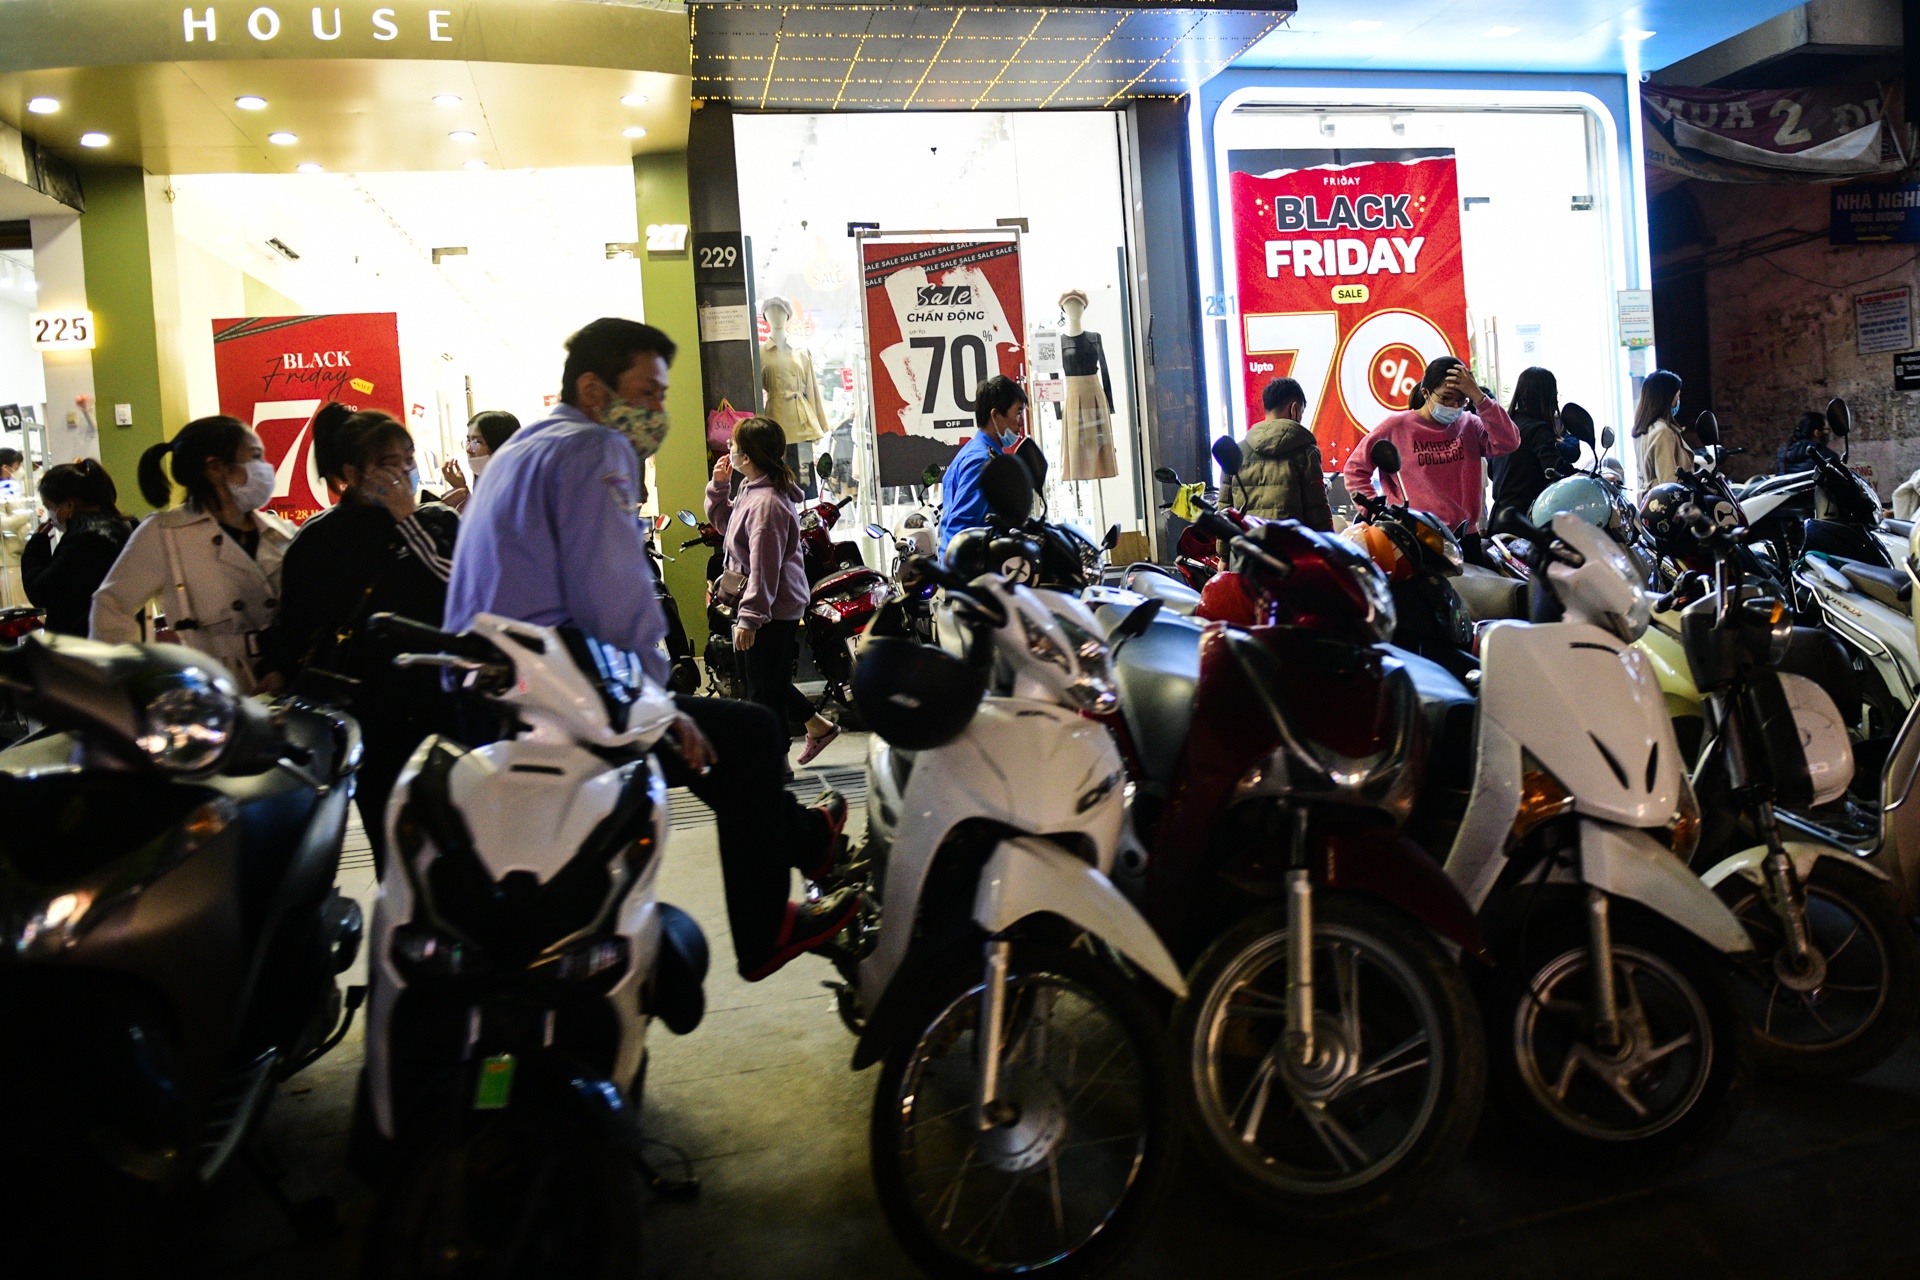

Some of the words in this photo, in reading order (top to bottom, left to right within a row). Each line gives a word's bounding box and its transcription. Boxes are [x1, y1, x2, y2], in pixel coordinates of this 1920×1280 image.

[182, 6, 453, 42] HOUSE
[1769, 99, 1812, 146] 2
[1836, 190, 1872, 210] NHÀ
[1275, 194, 1414, 232] BLACK
[700, 246, 737, 268] 229
[881, 258, 899, 268] SALE
[900, 253, 918, 263] SALE
[919, 249, 936, 259] SALE
[938, 245, 955, 255] SALE
[956, 241, 974, 250] SALE
[1264, 236, 1426, 279] FRIDAY
[865, 277, 883, 287] SALE
[940, 260, 957, 270] SALE
[958, 255, 976, 264] SALE
[977, 250, 994, 260] SALE
[995, 246, 1013, 256] SALE
[914, 283, 972, 311] Sale
[1338, 289, 1363, 299] SALE
[907, 309, 943, 323] CHẤN
[947, 309, 985, 323] ĐỘNG
[1206, 295, 1236, 317] 231
[35, 317, 87, 342] 225
[283, 350, 352, 369] BLACK
[1250, 362, 1274, 374] Upto
[262, 356, 352, 402] Friday
[4, 415, 20, 427] 70
[946, 420, 961, 428] OFF
[1413, 434, 1464, 453] AMHERST
[1417, 447, 1465, 466] COLLEGE
